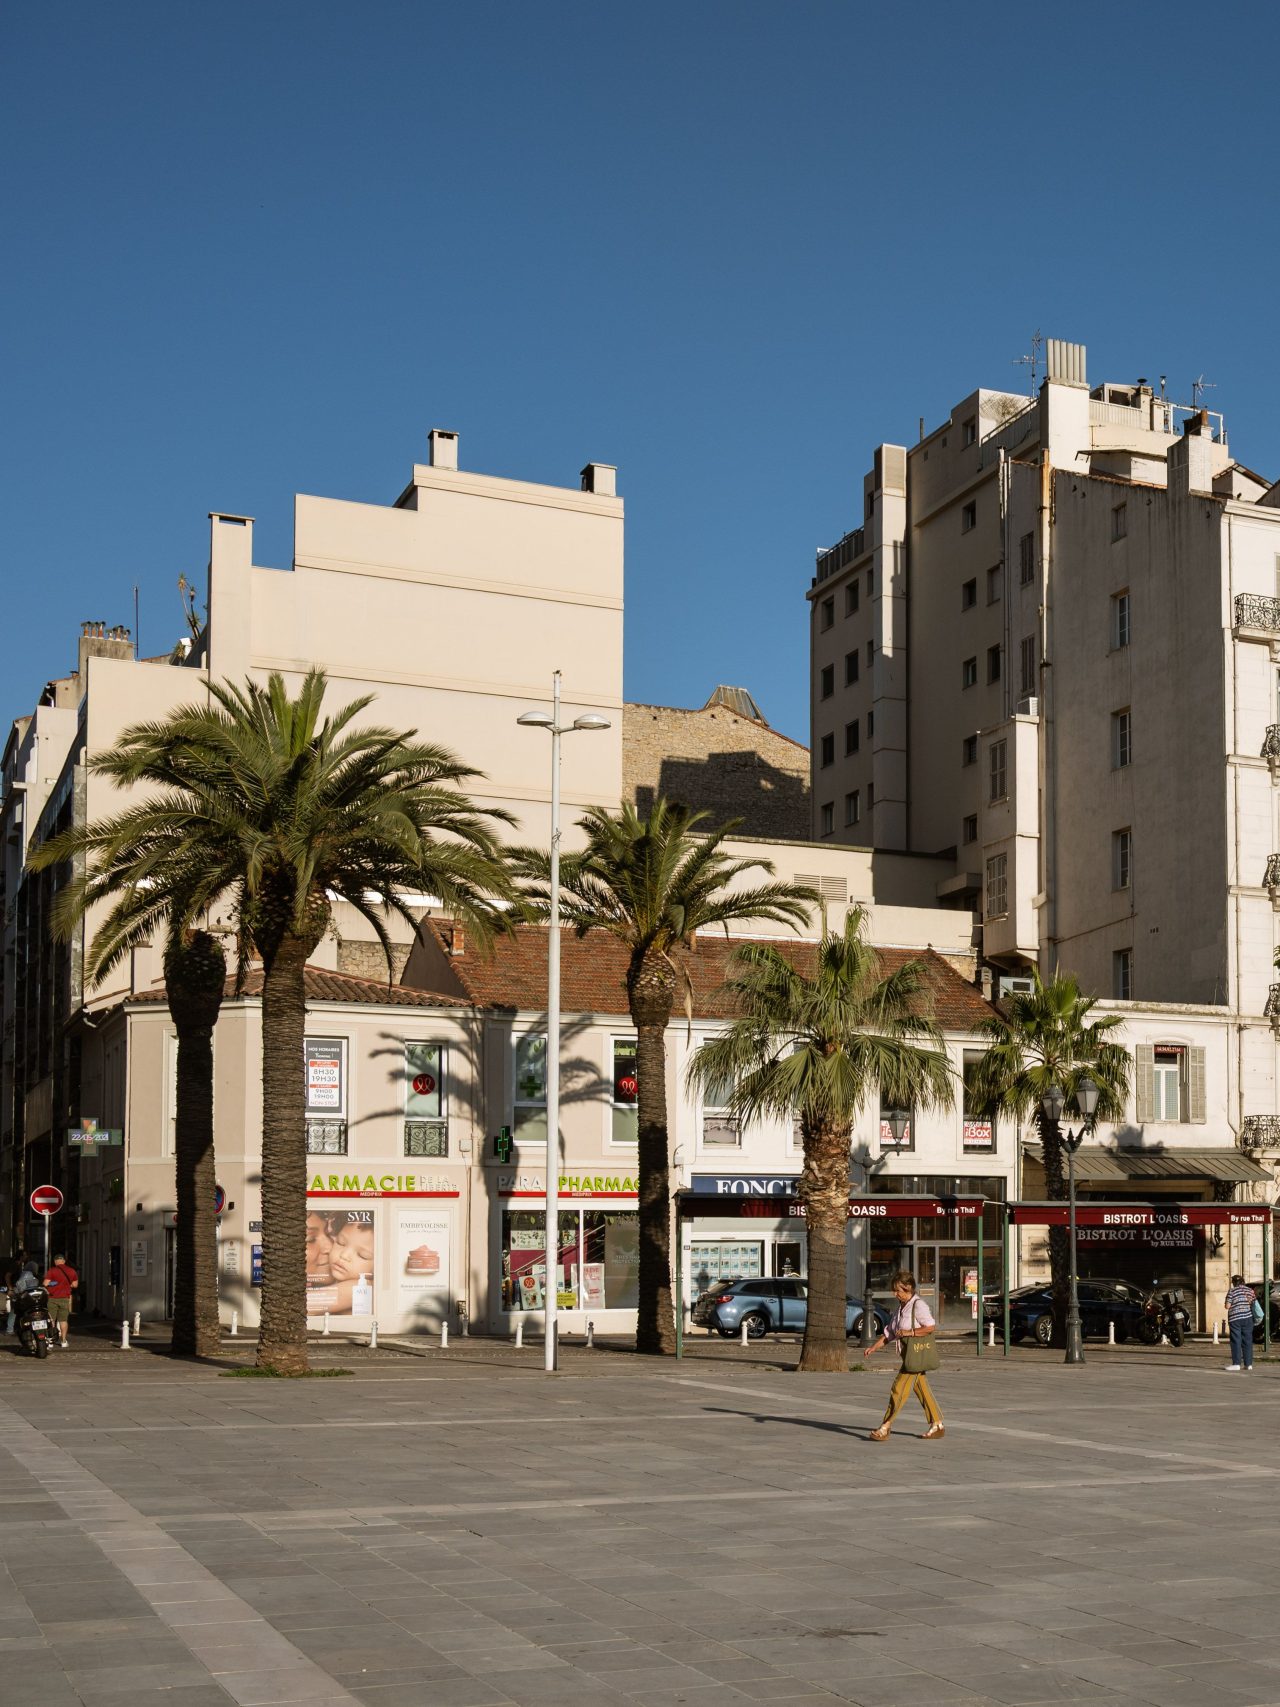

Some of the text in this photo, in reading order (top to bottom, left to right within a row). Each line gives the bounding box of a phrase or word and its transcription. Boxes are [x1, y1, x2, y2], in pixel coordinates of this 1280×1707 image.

[964, 1126, 991, 1138] iBox
[310, 1174, 416, 1191] ARMACIE
[498, 1176, 544, 1191] PARA
[716, 1179, 801, 1194] FONCI
[788, 1205, 887, 1216] BIS 'OASIS
[936, 1207, 946, 1215] By
[347, 1211, 372, 1222] SVR
[1104, 1214, 1189, 1224] BISTROT L'OASIS
[1230, 1214, 1239, 1223] By
[1077, 1229, 1194, 1241] BISTROT L'OASIS
[1150, 1240, 1159, 1248] by
